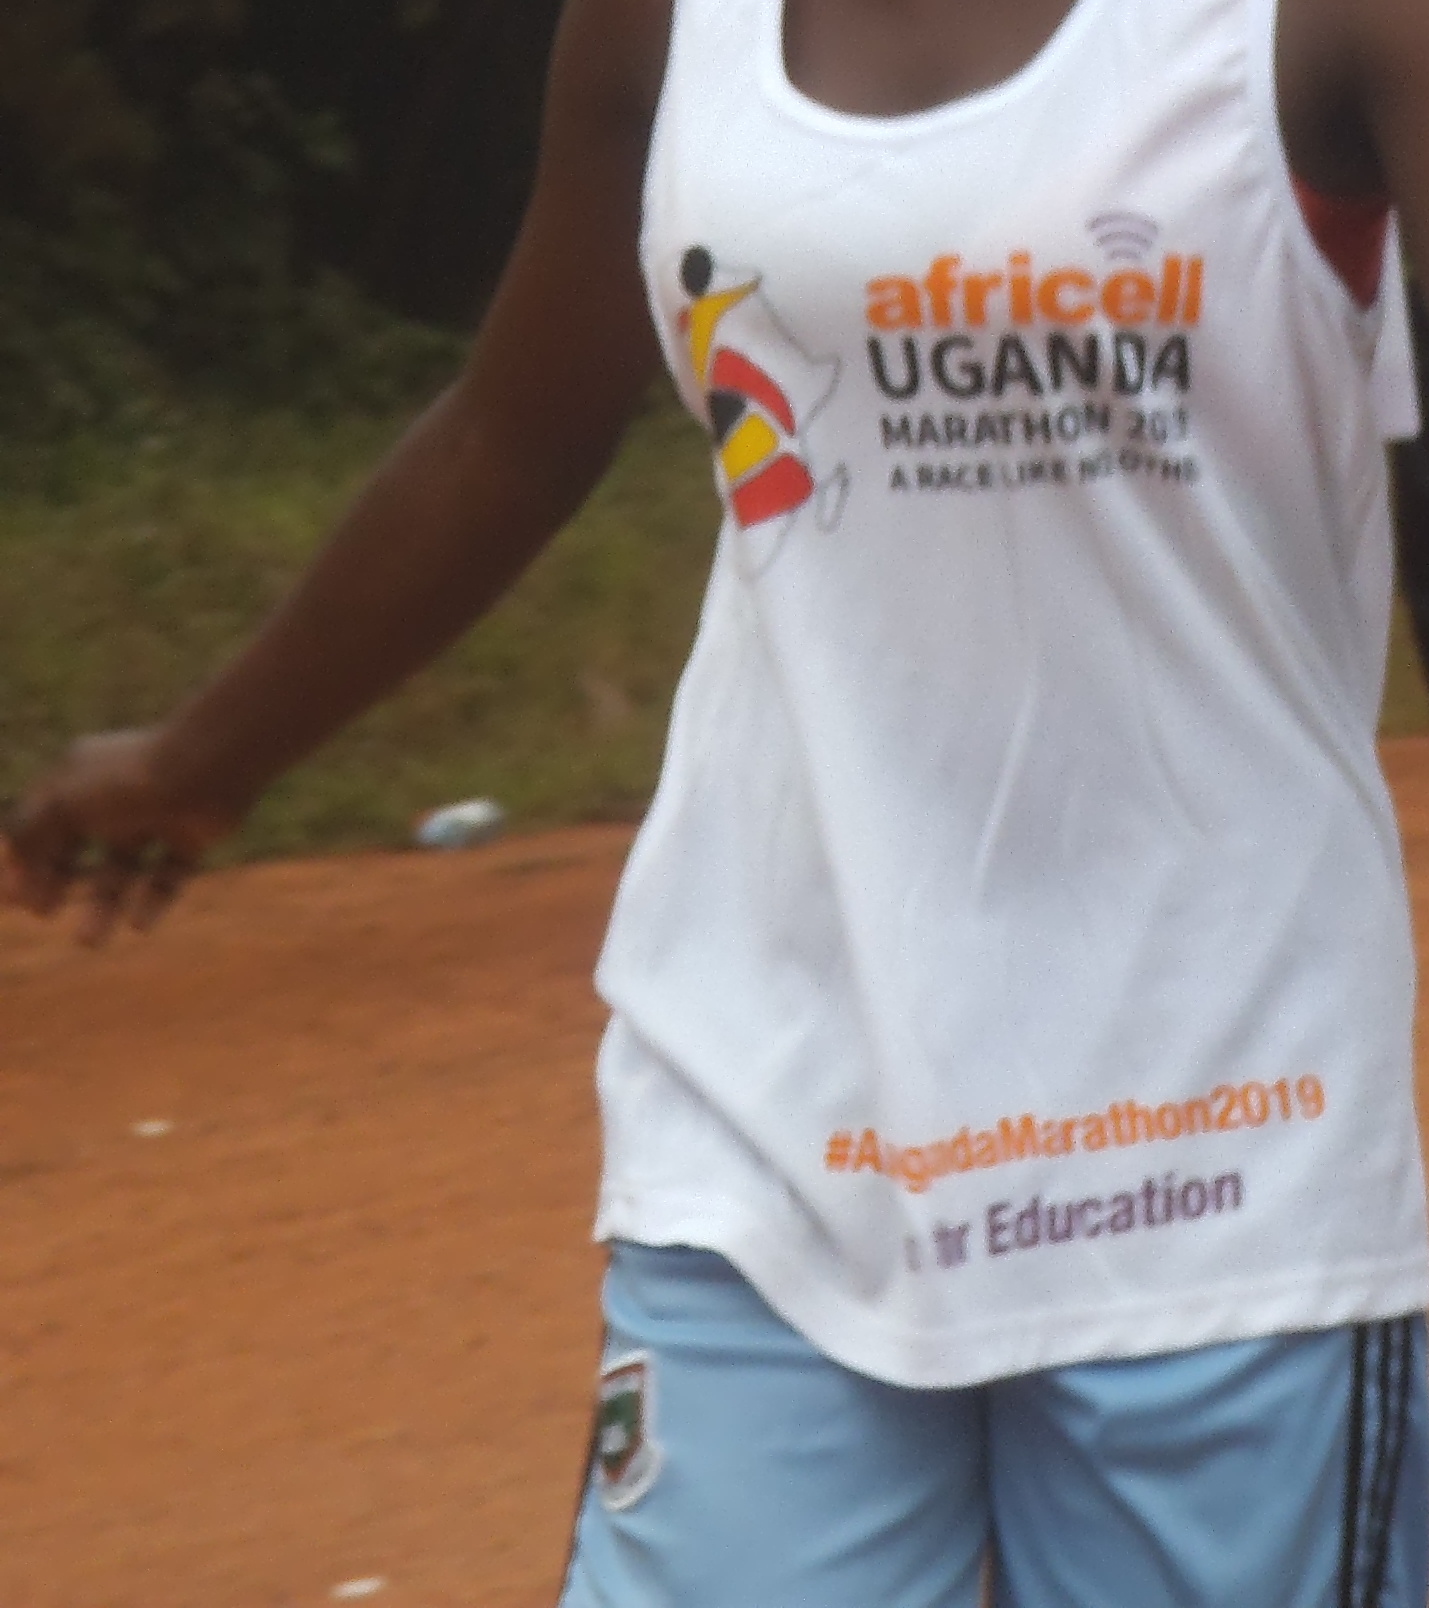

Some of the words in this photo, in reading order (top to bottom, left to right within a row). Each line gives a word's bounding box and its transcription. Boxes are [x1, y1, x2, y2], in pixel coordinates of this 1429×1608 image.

[865, 252, 1204, 330] africell
[866, 331, 1192, 399] UGANDA
[880, 401, 1110, 449] MARATHON
[985, 1168, 1245, 1258] Education
